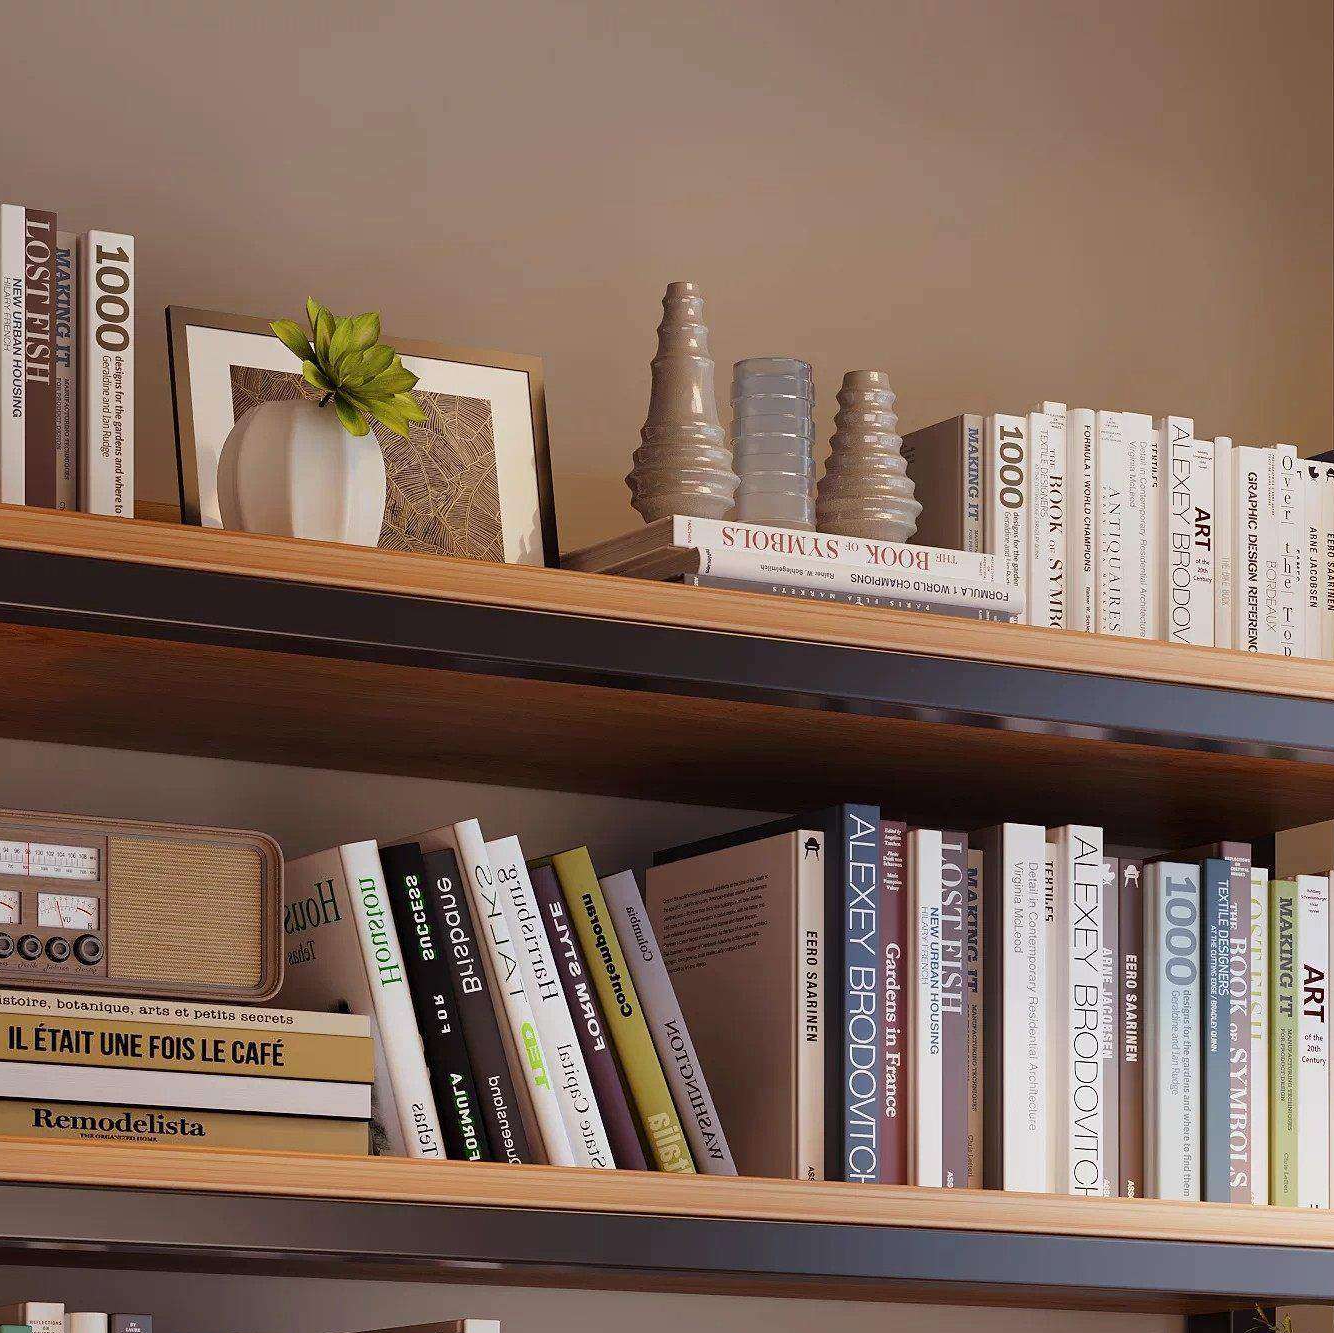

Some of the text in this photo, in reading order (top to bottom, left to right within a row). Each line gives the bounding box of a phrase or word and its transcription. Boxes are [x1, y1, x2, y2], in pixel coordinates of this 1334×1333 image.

[25, 219, 51, 385] LOST FISH
[96, 244, 130, 351] 1000
[12, 278, 23, 418] NEW URBAN HOUSING
[999, 425, 1023, 509] 1000
[722, 527, 958, 570] THE BOOK OF SYMBOLS
[1108, 489, 1121, 632] ANTIQUAIRES
[1195, 507, 1210, 551] ART
[850, 573, 911, 590] CHAMPIONS
[913, 581, 951, 595] WORLD
[961, 586, 1010, 602] FORMULA
[849, 814, 875, 955] ALEXEY
[1165, 877, 1197, 986] 1000
[57, 999, 135, 1017] botanique,
[139, 1004, 169, 1017] arts
[174, 1006, 189, 1018] et
[193, 1009, 235, 1023] petits
[239, 1011, 294, 1025] secrets
[806, 931, 818, 1043] EERO SAARINEN
[1126, 955, 1138, 1062] EERO SAARINEN
[1303, 964, 1325, 1022] ART
[9, 1023, 285, 1066] IL ÉTAIT UNE FOIS LE CAFÉ
[885, 943, 900, 1117] Gardens in France
[31, 1107, 206, 1137] Remodelista
